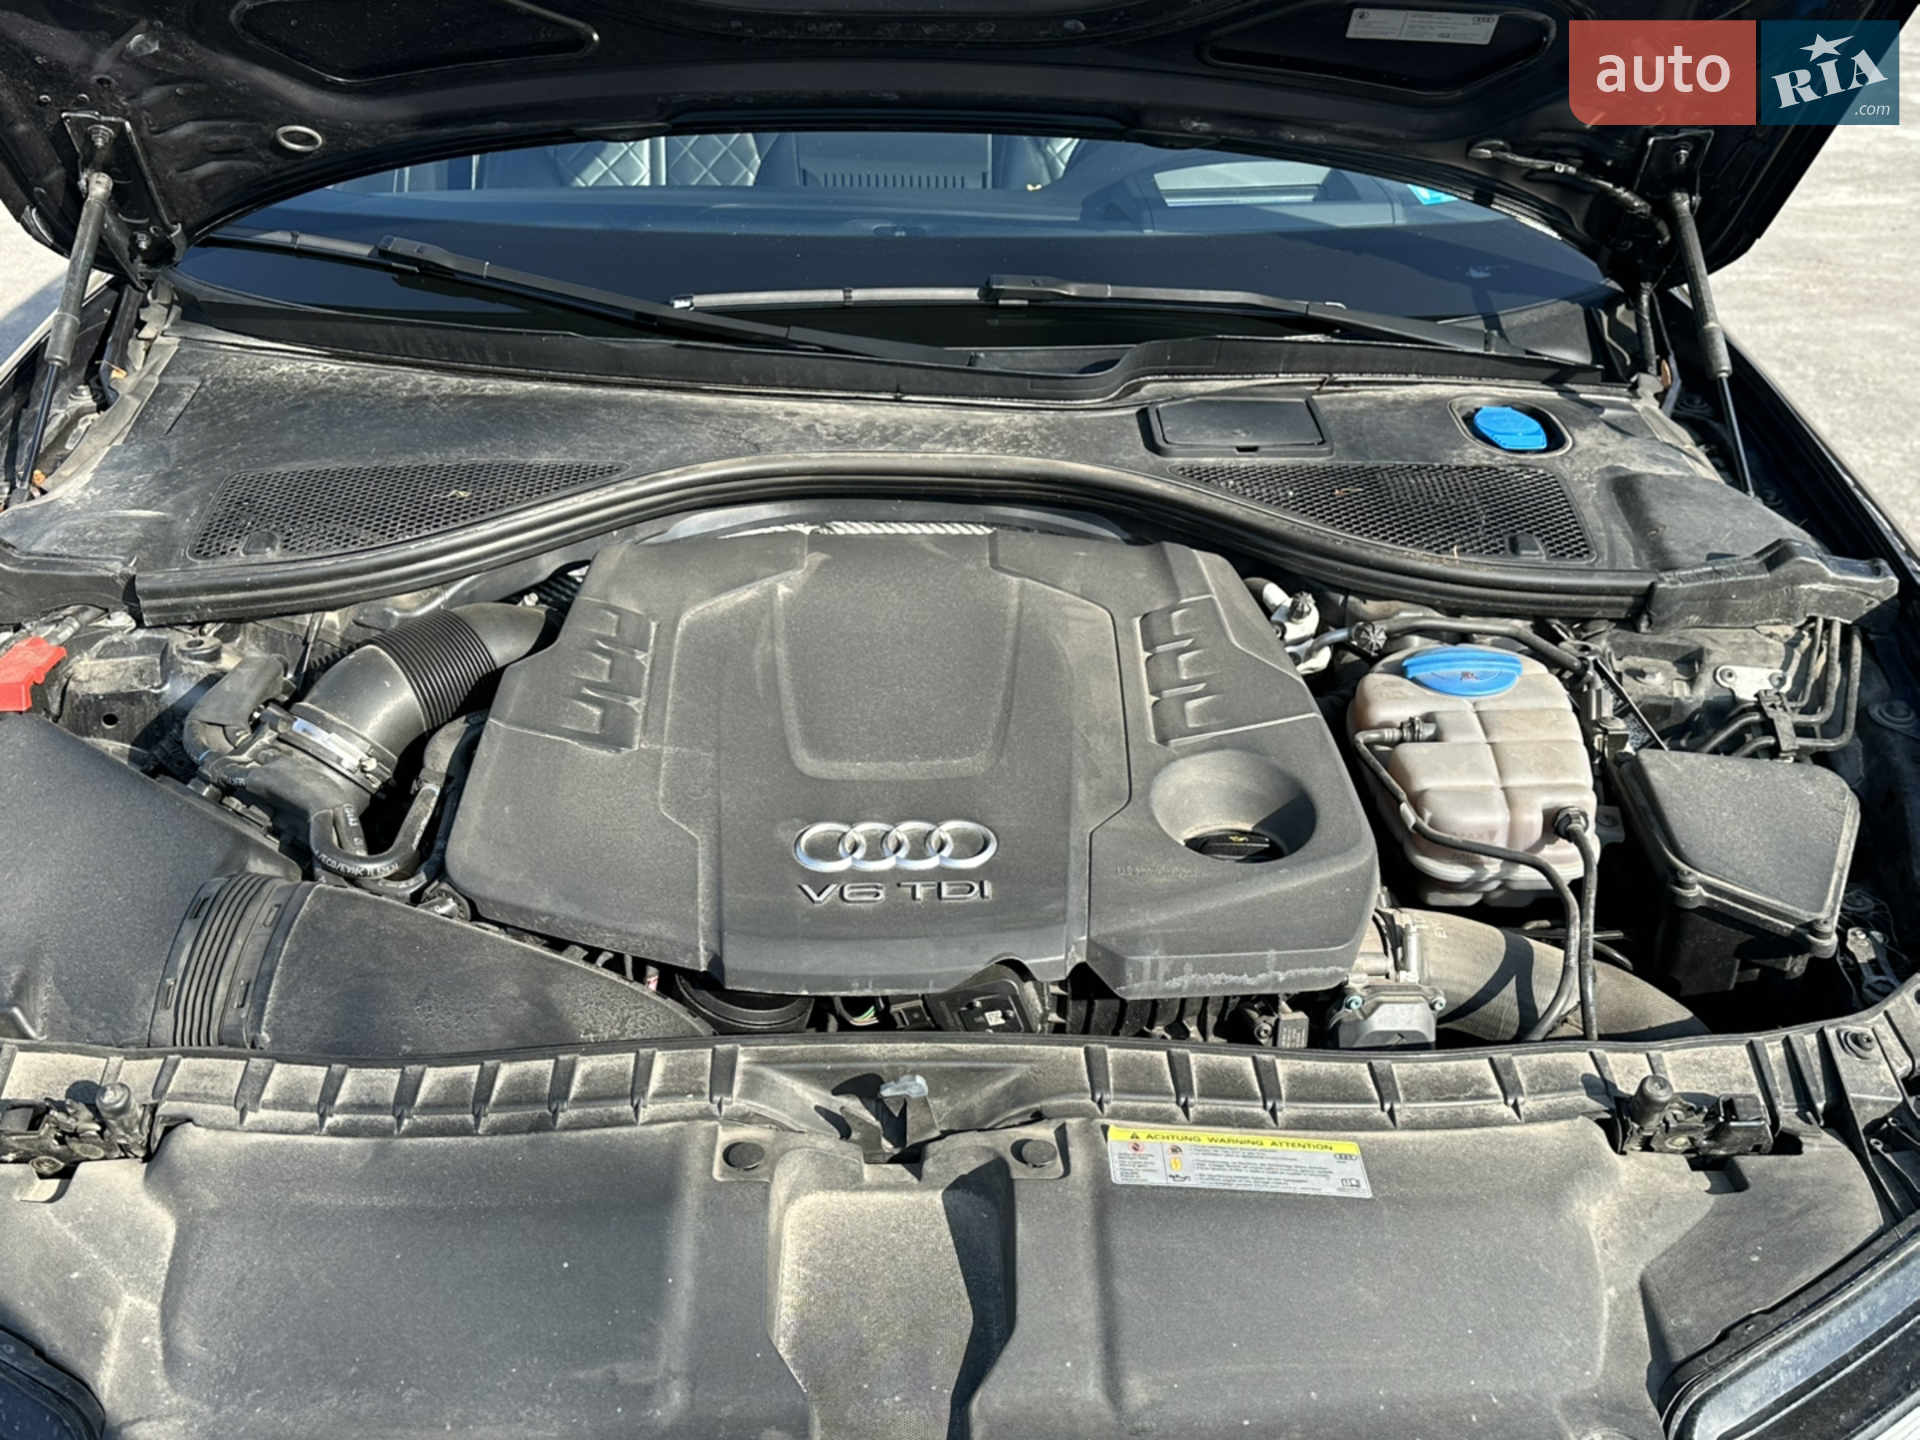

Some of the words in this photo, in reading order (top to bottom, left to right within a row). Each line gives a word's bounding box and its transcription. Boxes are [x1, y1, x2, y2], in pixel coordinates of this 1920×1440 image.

[797, 882, 886, 904] V6
[896, 880, 993, 902] TDI
[1146, 1133, 1201, 1143] ACHTUNG
[1207, 1136, 1264, 1146] WARNING
[1270, 1140, 1333, 1151] ATTENTION
